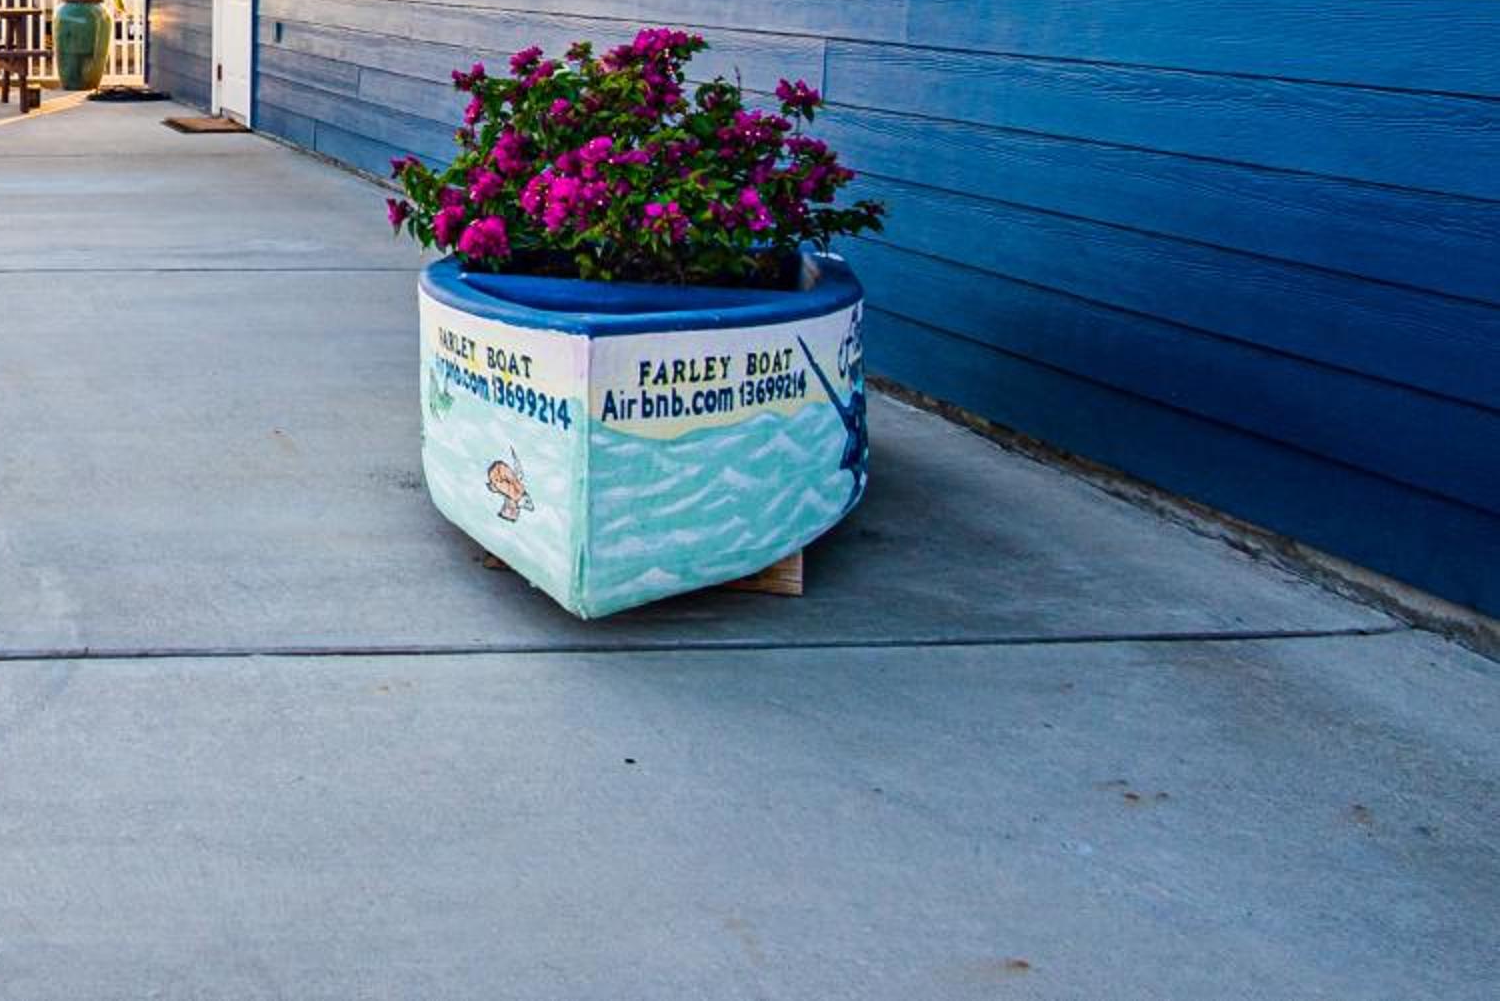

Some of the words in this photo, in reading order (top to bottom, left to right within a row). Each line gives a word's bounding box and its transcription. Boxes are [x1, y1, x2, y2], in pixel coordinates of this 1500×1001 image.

[486, 346, 533, 379] BOAT
[638, 355, 731, 386] FARLEY
[746, 348, 793, 376] BOAT
[492, 375, 572, 430] 13699214
[601, 386, 734, 422] Airbnb.com
[739, 369, 806, 407] 13699214
